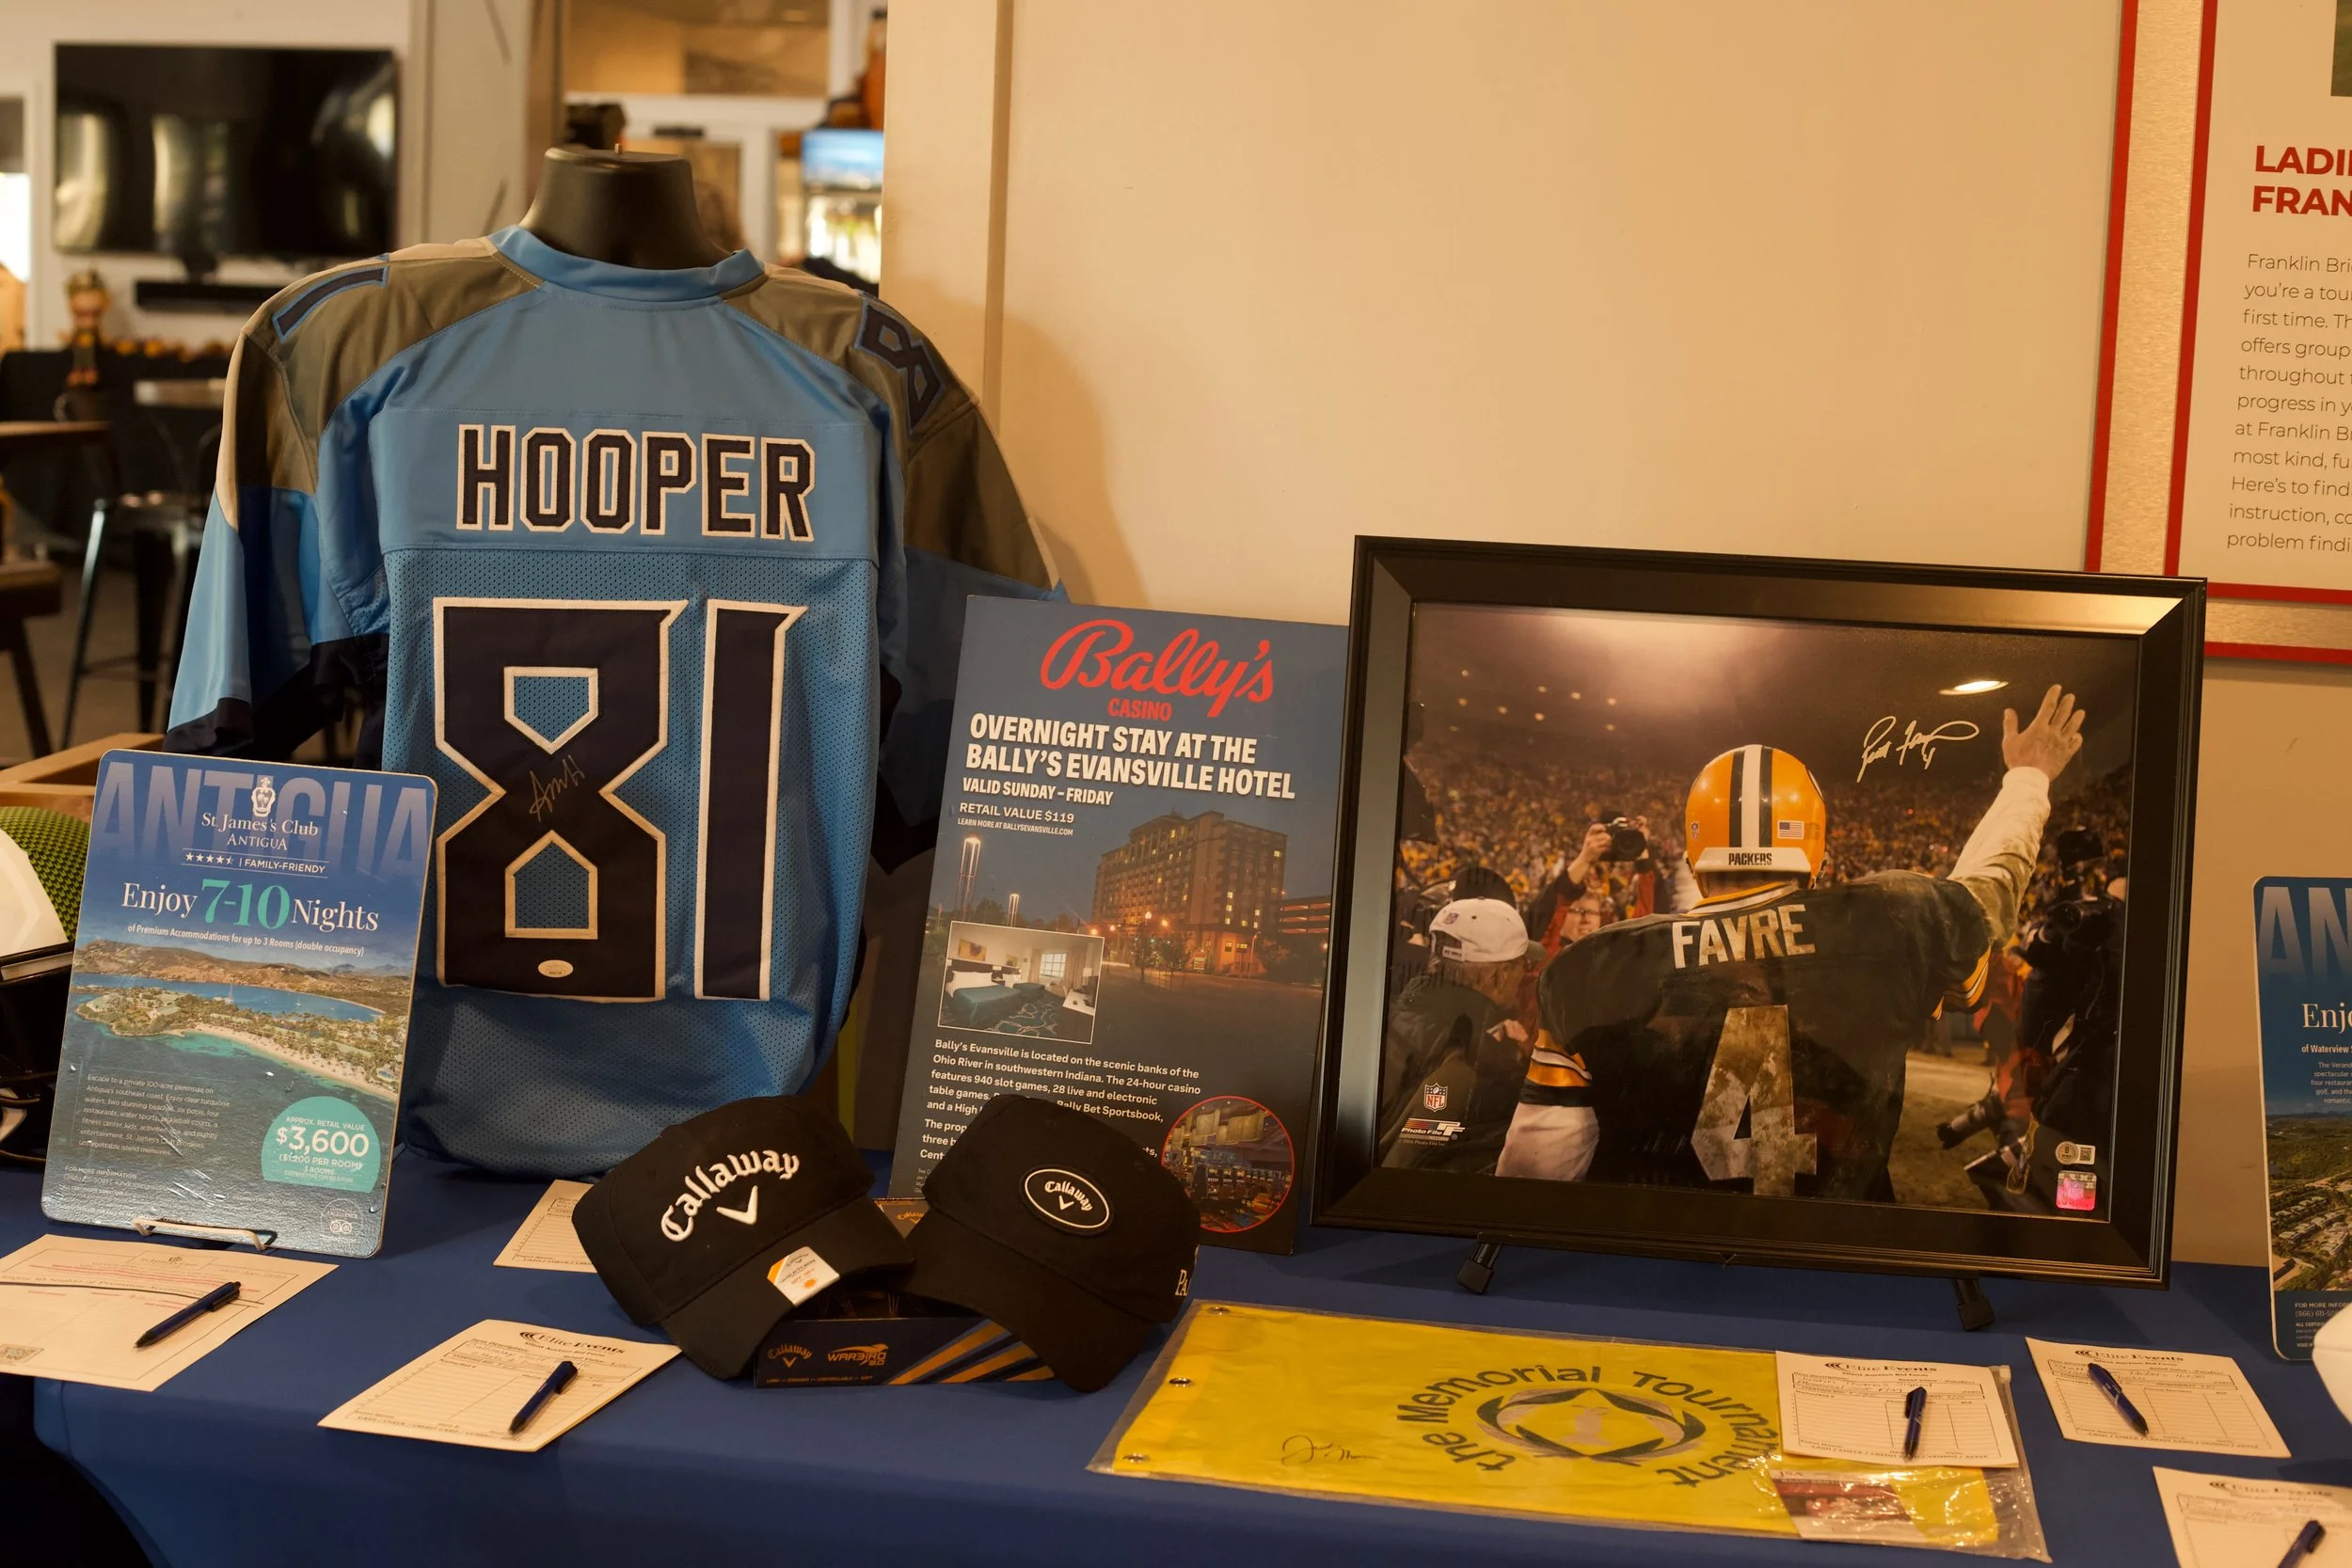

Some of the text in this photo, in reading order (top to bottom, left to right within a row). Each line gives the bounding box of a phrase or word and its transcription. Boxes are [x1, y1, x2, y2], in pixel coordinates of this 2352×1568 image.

[2255, 145, 2352, 177] LADI
[2248, 254, 2352, 273] Franklin Bri
[2244, 282, 2352, 301] you're a tou
[2244, 309, 2277, 326] first
[2283, 311, 2328, 328] time.
[2241, 337, 2291, 355] offers
[2239, 364, 2344, 386] throughout
[2237, 395, 2352, 417] progress in y
[2235, 422, 2252, 436] at
[2258, 421, 2330, 440] Franklin
[2233, 451, 2280, 466] most
[2285, 451, 2328, 470] kind,
[456, 424, 816, 544] HOOPER
[2232, 476, 2287, 493] Here's
[2291, 481, 2309, 495] to
[2230, 503, 2329, 526] instruction,
[2228, 532, 2303, 551] problem
[1040, 618, 1274, 718] Bally's
[1108, 698, 1172, 721] CASINO
[970, 712, 1258, 764] OVERNIGHT STAY AT THE
[965, 743, 1296, 800] BALLY'S EVANSVILLE HOTEL
[432, 596, 808, 1004] 81
[962, 777, 1114, 807] VALID SUNDAY FRIDAY
[200, 812, 318, 836] St James's Club
[960, 802, 1075, 825] RETAIL VALUE $119
[958, 817, 1074, 836] LEARN MORE AT BALLYSEVANSVILLE.COM
[227, 836, 288, 850] ANTIGUA
[245, 858, 326, 874] FAMILY-FRIENDY
[1728, 853, 1773, 866] PACKERS
[120, 878, 379, 932] Enjoy 7-10 Nights
[128, 924, 365, 957] of Premium Accommodations for up to 3 Rooms (double occupancy)
[1672, 904, 1817, 970] FAVRE
[2302, 1002, 2352, 1034] Enj
[2301, 1043, 2349, 1053] of Waterview
[935, 1039, 1200, 1081] Bally's Evansville is located on the scenic banks of the
[933, 1054, 1201, 1097] Ohio River in southwestern Indiana. The 24-hour casino
[931, 1069, 1158, 1106] features 940 slot games, 28 live and electronic
[927, 1101, 946, 1111] and
[954, 1103, 977, 1117] High
[929, 1085, 955, 1097] table
[956, 1089, 991, 1101] games.
[1084, 1103, 1101, 1115] Bet
[1102, 1105, 1164, 1123] Sportsbook,
[1426, 1094, 1444, 1108] NFL
[1692, 1005, 1818, 1196] 4
[285, 1116, 366, 1132] APPROX. RETAIL VALUE
[925, 1118, 943, 1130] The
[276, 1126, 370, 1158] $3,600
[922, 1133, 949, 1146] three
[312, 1156, 329, 1166] PER
[661, 1149, 801, 1243] Callaway
[1044, 1178, 1093, 1212] Callaway
[574, 1340, 626, 1354] Events
[1883, 1365, 1938, 1374] Events
[1396, 1364, 1602, 1425] Memorial
[1422, 1431, 1517, 1472] the
